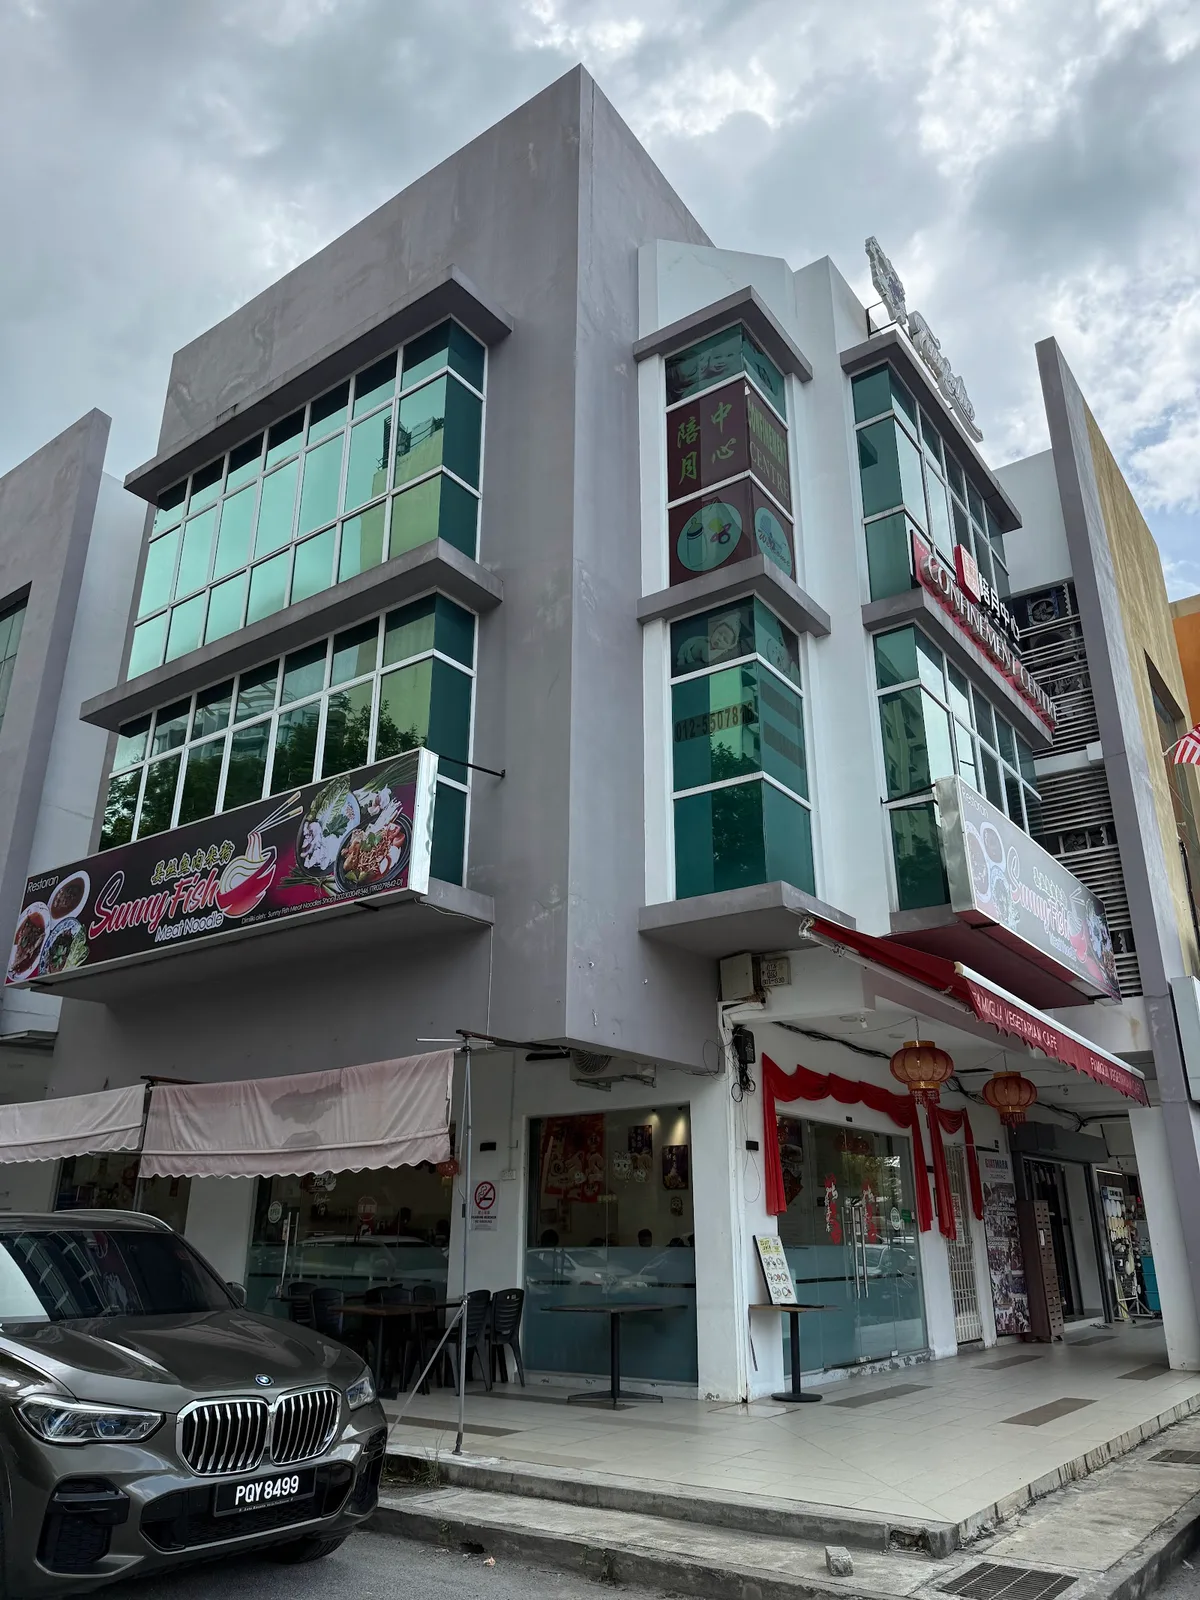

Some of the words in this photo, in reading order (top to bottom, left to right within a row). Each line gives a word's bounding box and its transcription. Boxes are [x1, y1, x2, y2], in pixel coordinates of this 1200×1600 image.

[749, 441, 790, 500] CENTRE
[924, 554, 1018, 675] CONFINEMENT
[978, 572, 1021, 642] 陪月中心
[961, 786, 989, 819] Restoran
[27, 875, 59, 893] Restoran
[88, 870, 171, 939] Sunny
[168, 868, 220, 918] Fish
[1006, 846, 1050, 934] Sunny
[154, 918, 184, 942] Meat
[183, 911, 224, 935] Noodle
[1004, 1008, 1042, 1041] VEGETARIAN
[1042, 1030, 1058, 1050] CAFE
